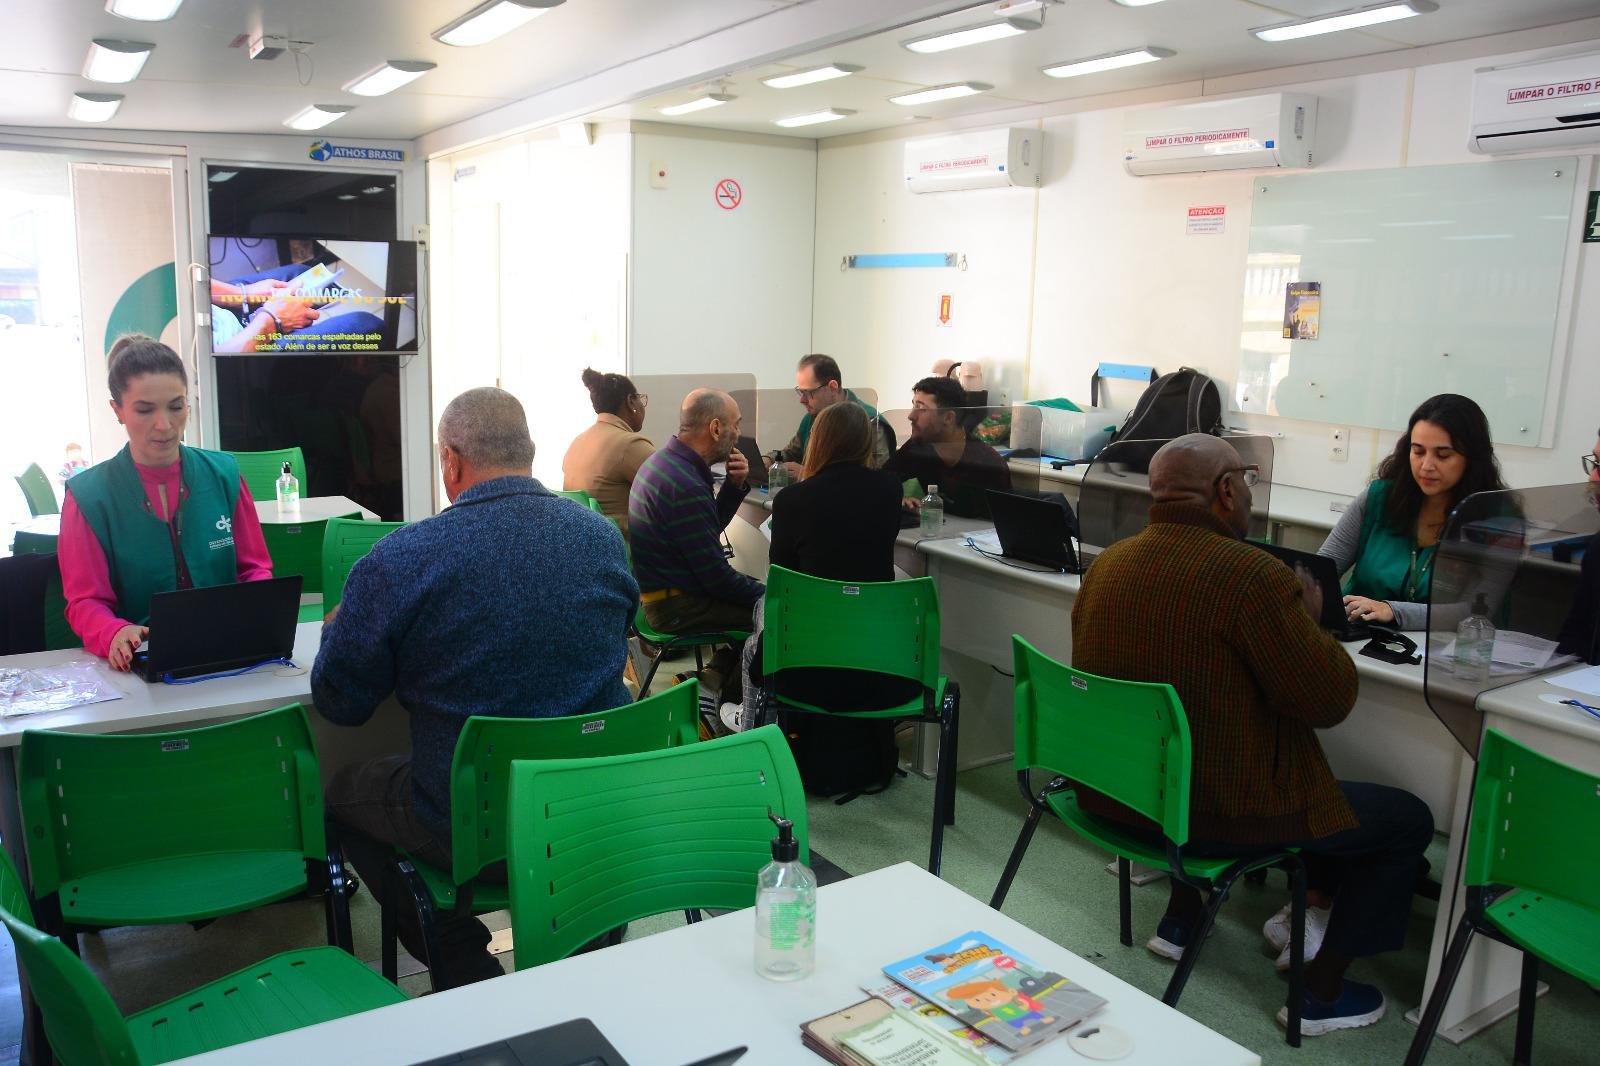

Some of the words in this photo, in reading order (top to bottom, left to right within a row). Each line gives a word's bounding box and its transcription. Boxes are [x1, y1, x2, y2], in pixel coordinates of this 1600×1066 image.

[1509, 88, 1544, 101] LIMPAR
[1547, 87, 1554, 96] O
[1557, 82, 1592, 95] FILTRO
[1168, 137, 1173, 145] O
[1174, 135, 1194, 144] FILTRO
[1195, 131, 1248, 142] PERIODICAMENTE
[334, 147, 366, 158] ATHOS
[368, 149, 401, 160] BRASIL
[322, 332, 364, 342] espalhadas
[365, 332, 382, 342] pelo
[306, 342, 316, 351] de
